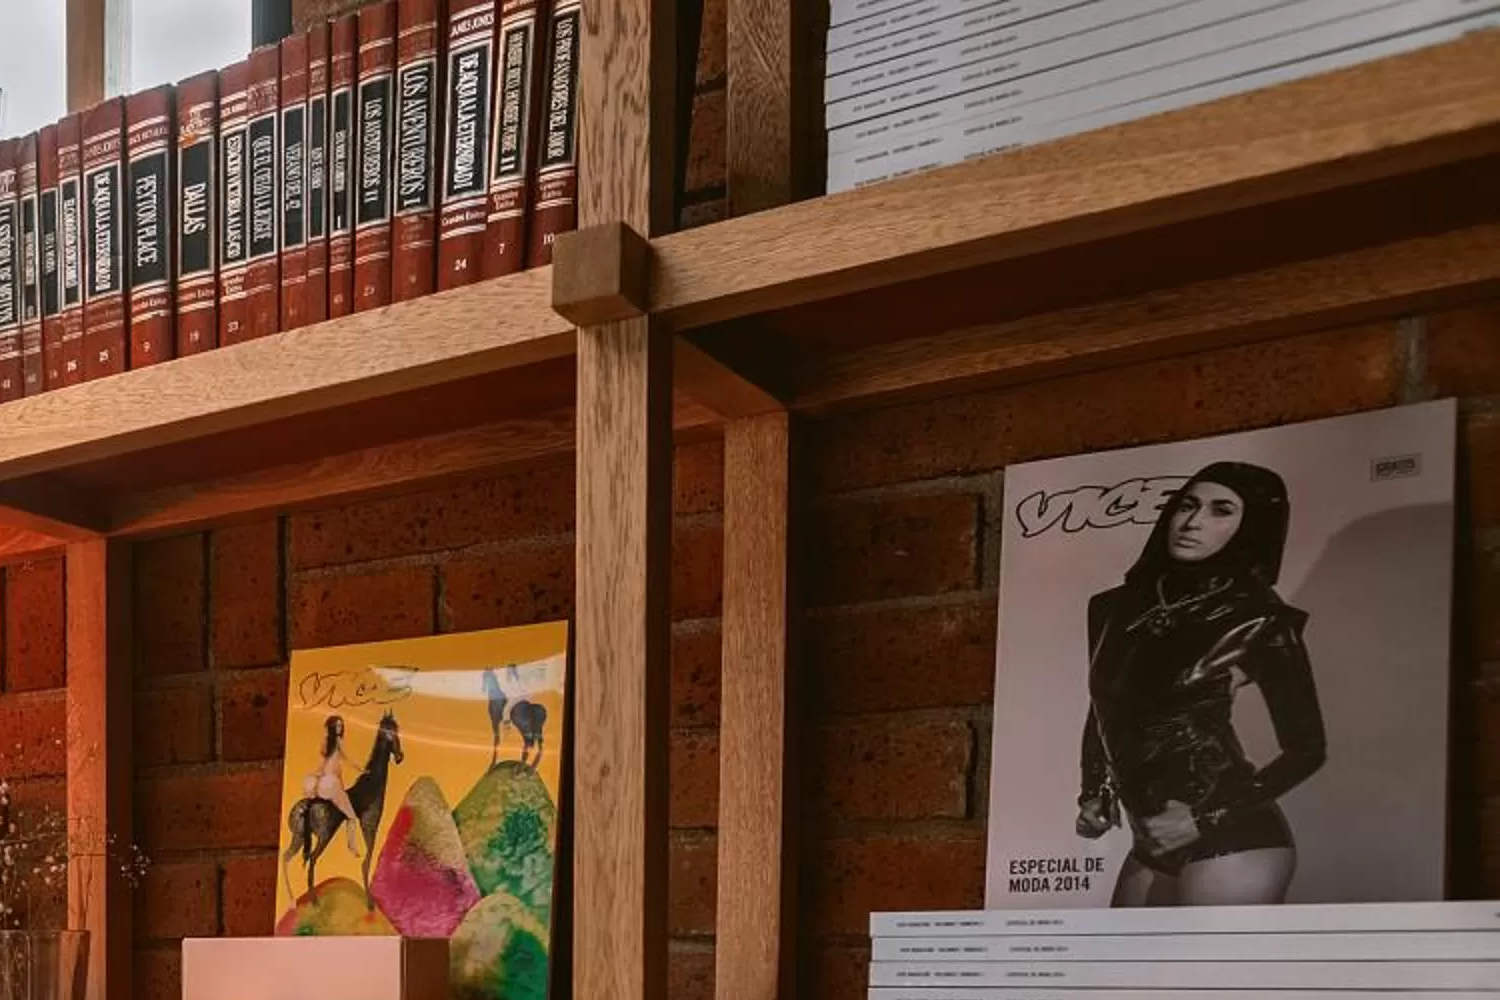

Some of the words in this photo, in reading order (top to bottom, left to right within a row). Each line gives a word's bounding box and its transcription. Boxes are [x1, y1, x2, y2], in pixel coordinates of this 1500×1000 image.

[403, 67, 429, 97] LOS
[365, 98, 382, 119] LOS
[363, 120, 381, 189] AVENTUREROS
[401, 100, 427, 195] AVENTUREROS
[136, 174, 157, 226] PEYTON
[183, 183, 206, 235] DALLAS
[137, 227, 157, 267] PLACE
[1009, 858, 1080, 875] ESPECIAL
[1084, 857, 1105, 873] DE
[1009, 877, 1050, 893] MODA
[1054, 875, 1090, 892] 2014
